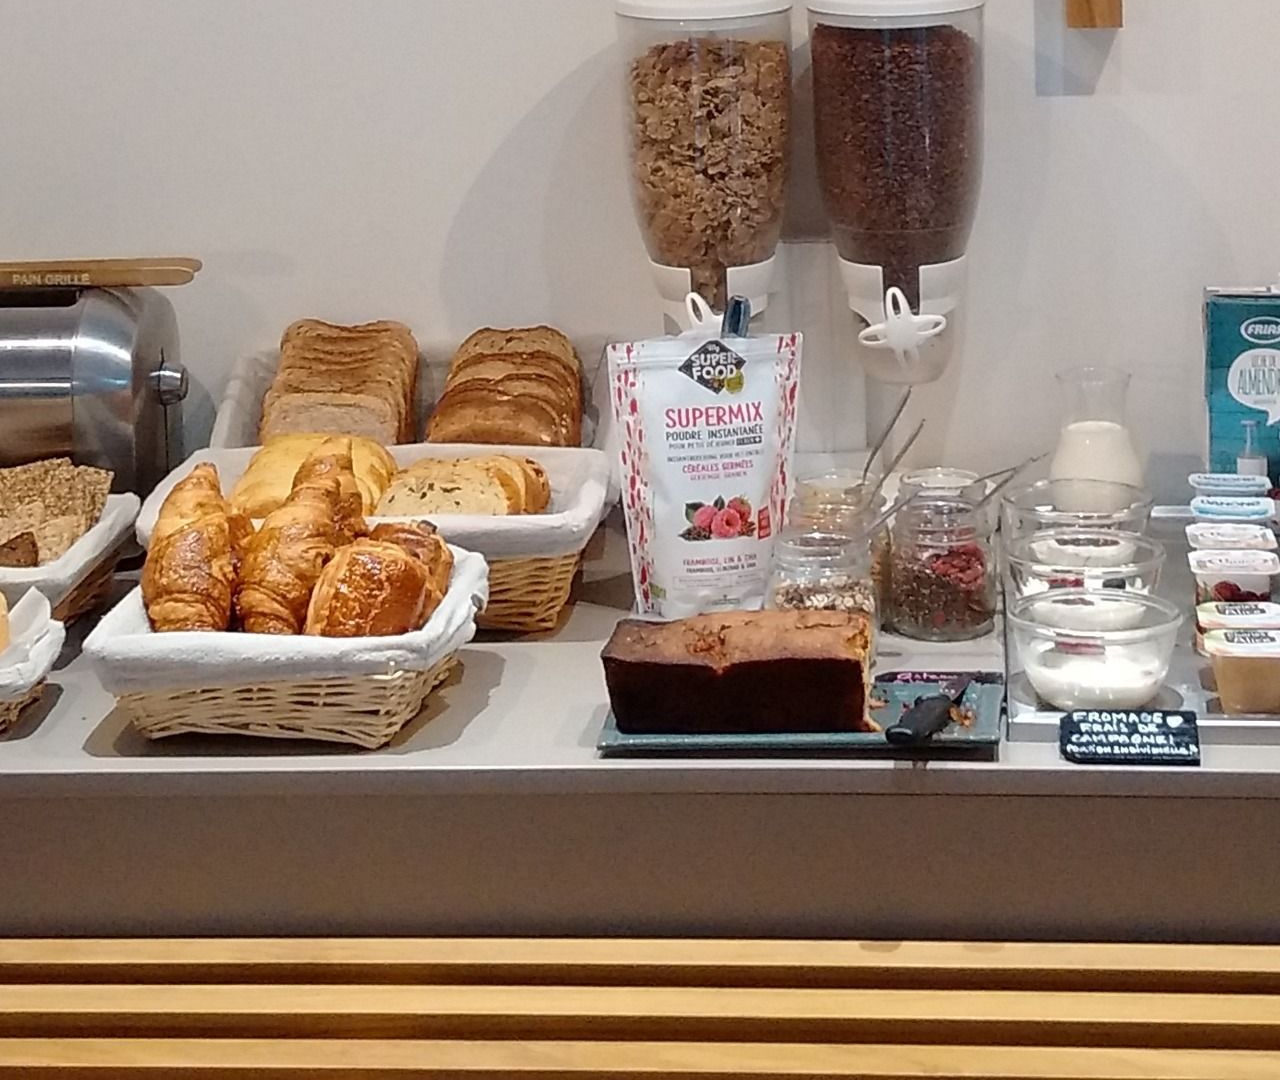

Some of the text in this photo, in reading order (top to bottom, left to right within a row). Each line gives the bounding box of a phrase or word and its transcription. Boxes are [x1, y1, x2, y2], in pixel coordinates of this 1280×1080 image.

[12, 274, 42, 285] PAIN
[690, 351, 739, 367] SUPER
[691, 364, 738, 381] FOOD
[664, 401, 764, 429] SUPERMIX
[665, 424, 764, 441] POUDRE INSTANTANÉE
[682, 463, 719, 473] CÉRÉALES
[1072, 711, 1163, 723] FROMAGE
